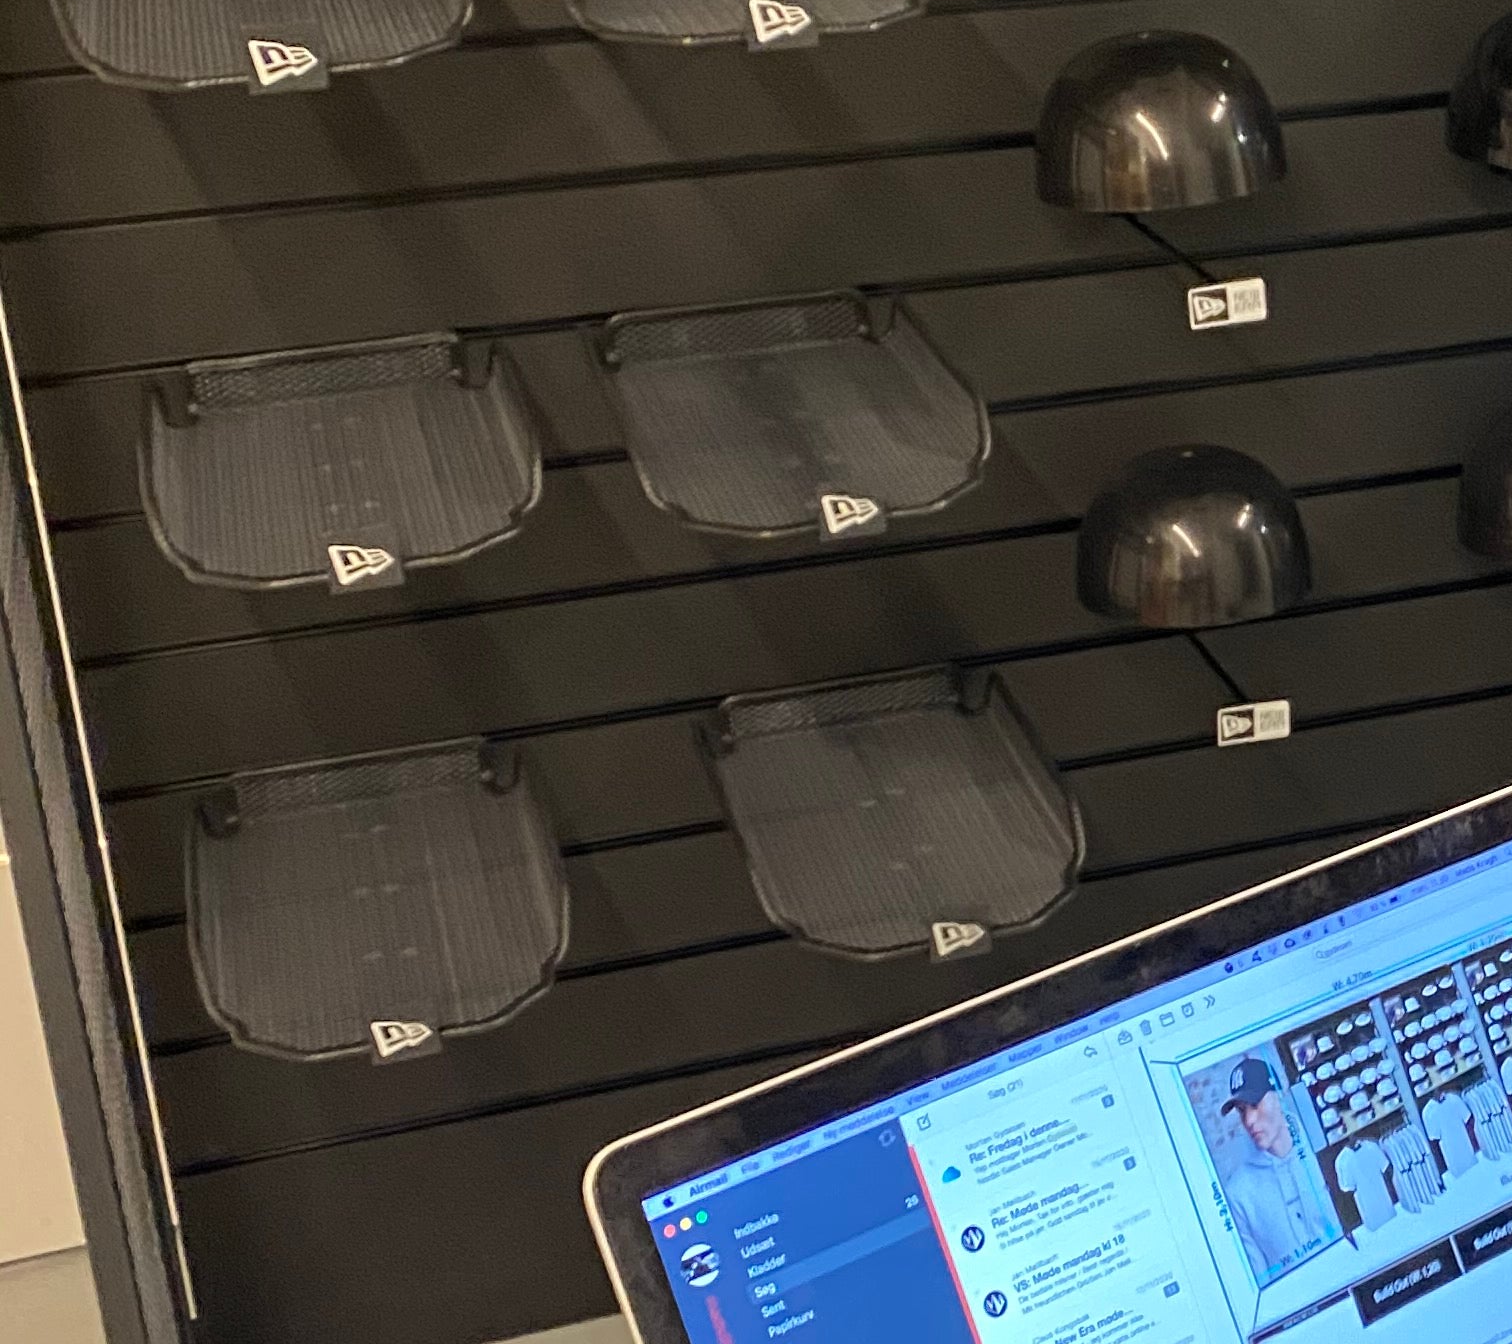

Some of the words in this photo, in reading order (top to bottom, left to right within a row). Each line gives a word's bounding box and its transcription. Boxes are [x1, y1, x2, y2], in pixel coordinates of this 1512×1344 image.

[968, 1148, 986, 1164] Re:
[987, 1132, 1024, 1158] Fredag
[687, 1172, 729, 1198] Airmail
[733, 1211, 780, 1240] Indbakke
[991, 1212, 1009, 1228] Re:
[746, 1252, 787, 1278] Kladder
[1013, 1277, 1031, 1293] VS:
[1061, 1244, 1102, 1273] mandag
[1112, 1233, 1125, 1246] 18
[753, 1280, 777, 1301] Søg
[760, 1298, 786, 1318] Sent
[767, 1308, 816, 1339] Papirkurv
[1077, 1321, 1096, 1338] Era
